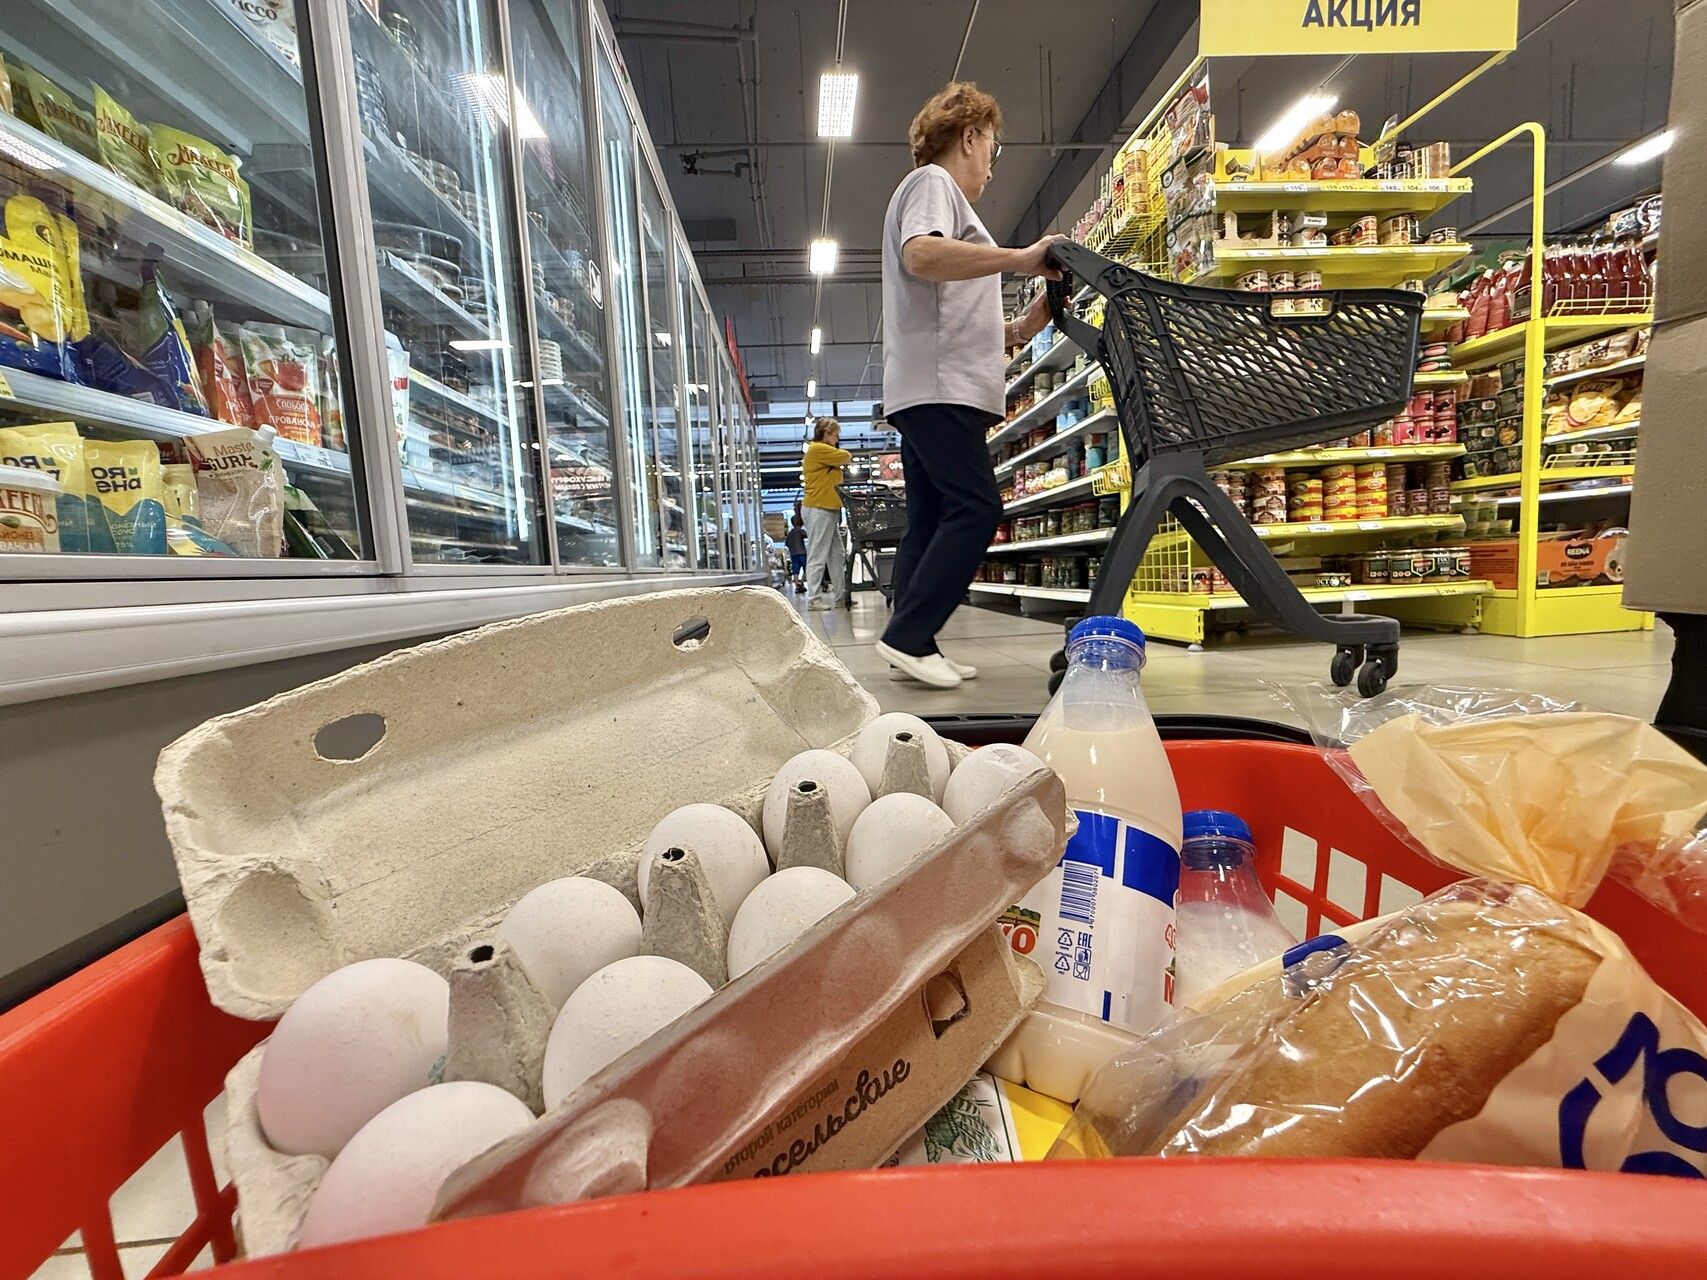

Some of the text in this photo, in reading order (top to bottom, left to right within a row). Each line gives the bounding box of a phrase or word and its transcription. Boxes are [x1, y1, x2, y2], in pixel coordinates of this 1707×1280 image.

[1301, 0, 1421, 31] АКЦИЯ
[1077, 931, 1093, 949] EAC
[776, 1079, 839, 1136] категории
